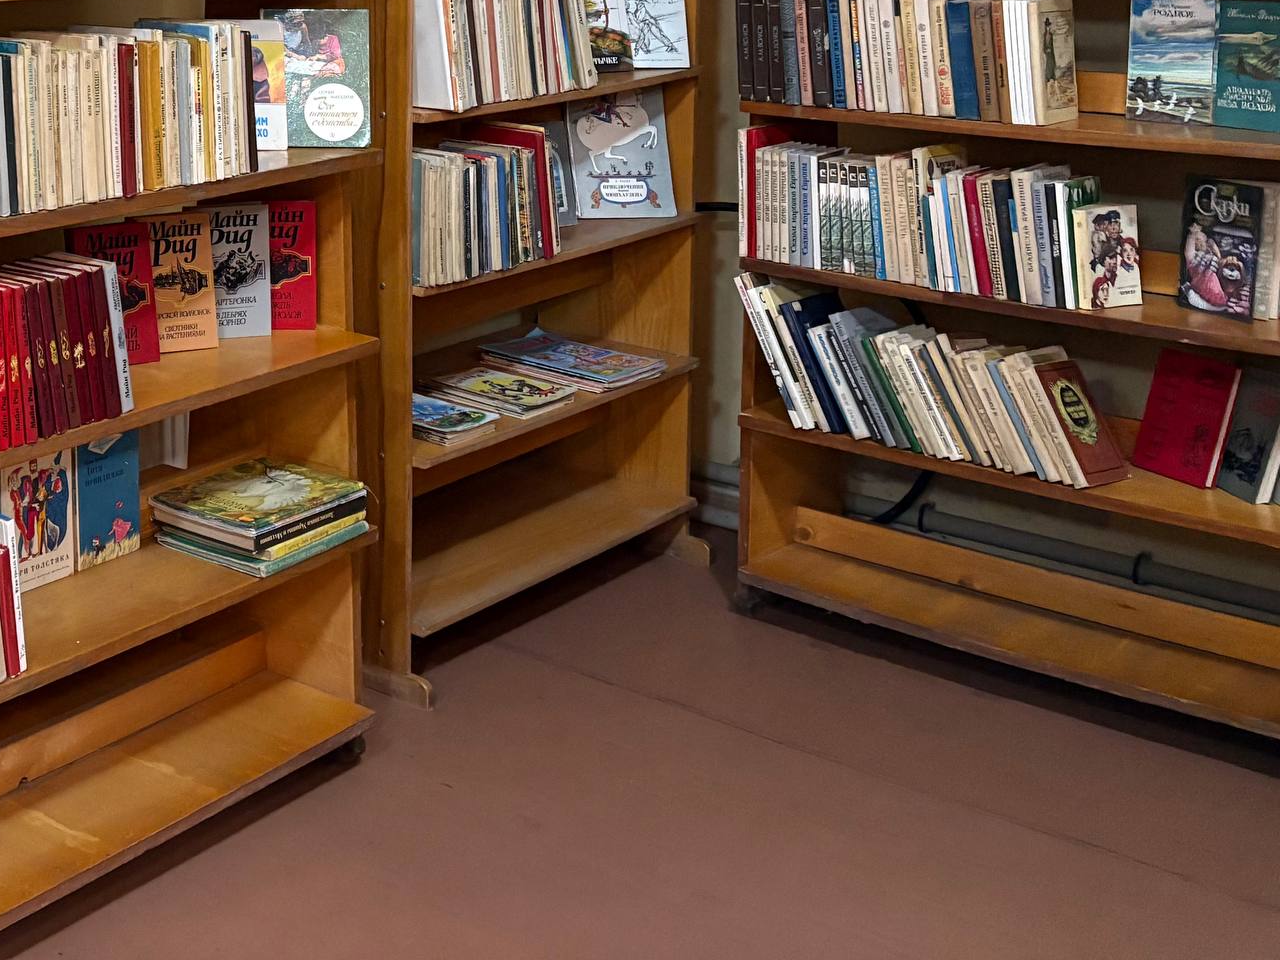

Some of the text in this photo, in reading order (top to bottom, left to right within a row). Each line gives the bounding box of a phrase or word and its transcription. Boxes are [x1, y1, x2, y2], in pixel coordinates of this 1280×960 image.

[1194, 183, 1251, 224] Сказки
[149, 219, 203, 238] Майн
[209, 210, 259, 230] Майн
[152, 238, 198, 268] Рид
[222, 310, 248, 320] ДЕБРЯХ
[31, 554, 70, 572] ТОЛСТЯКА
